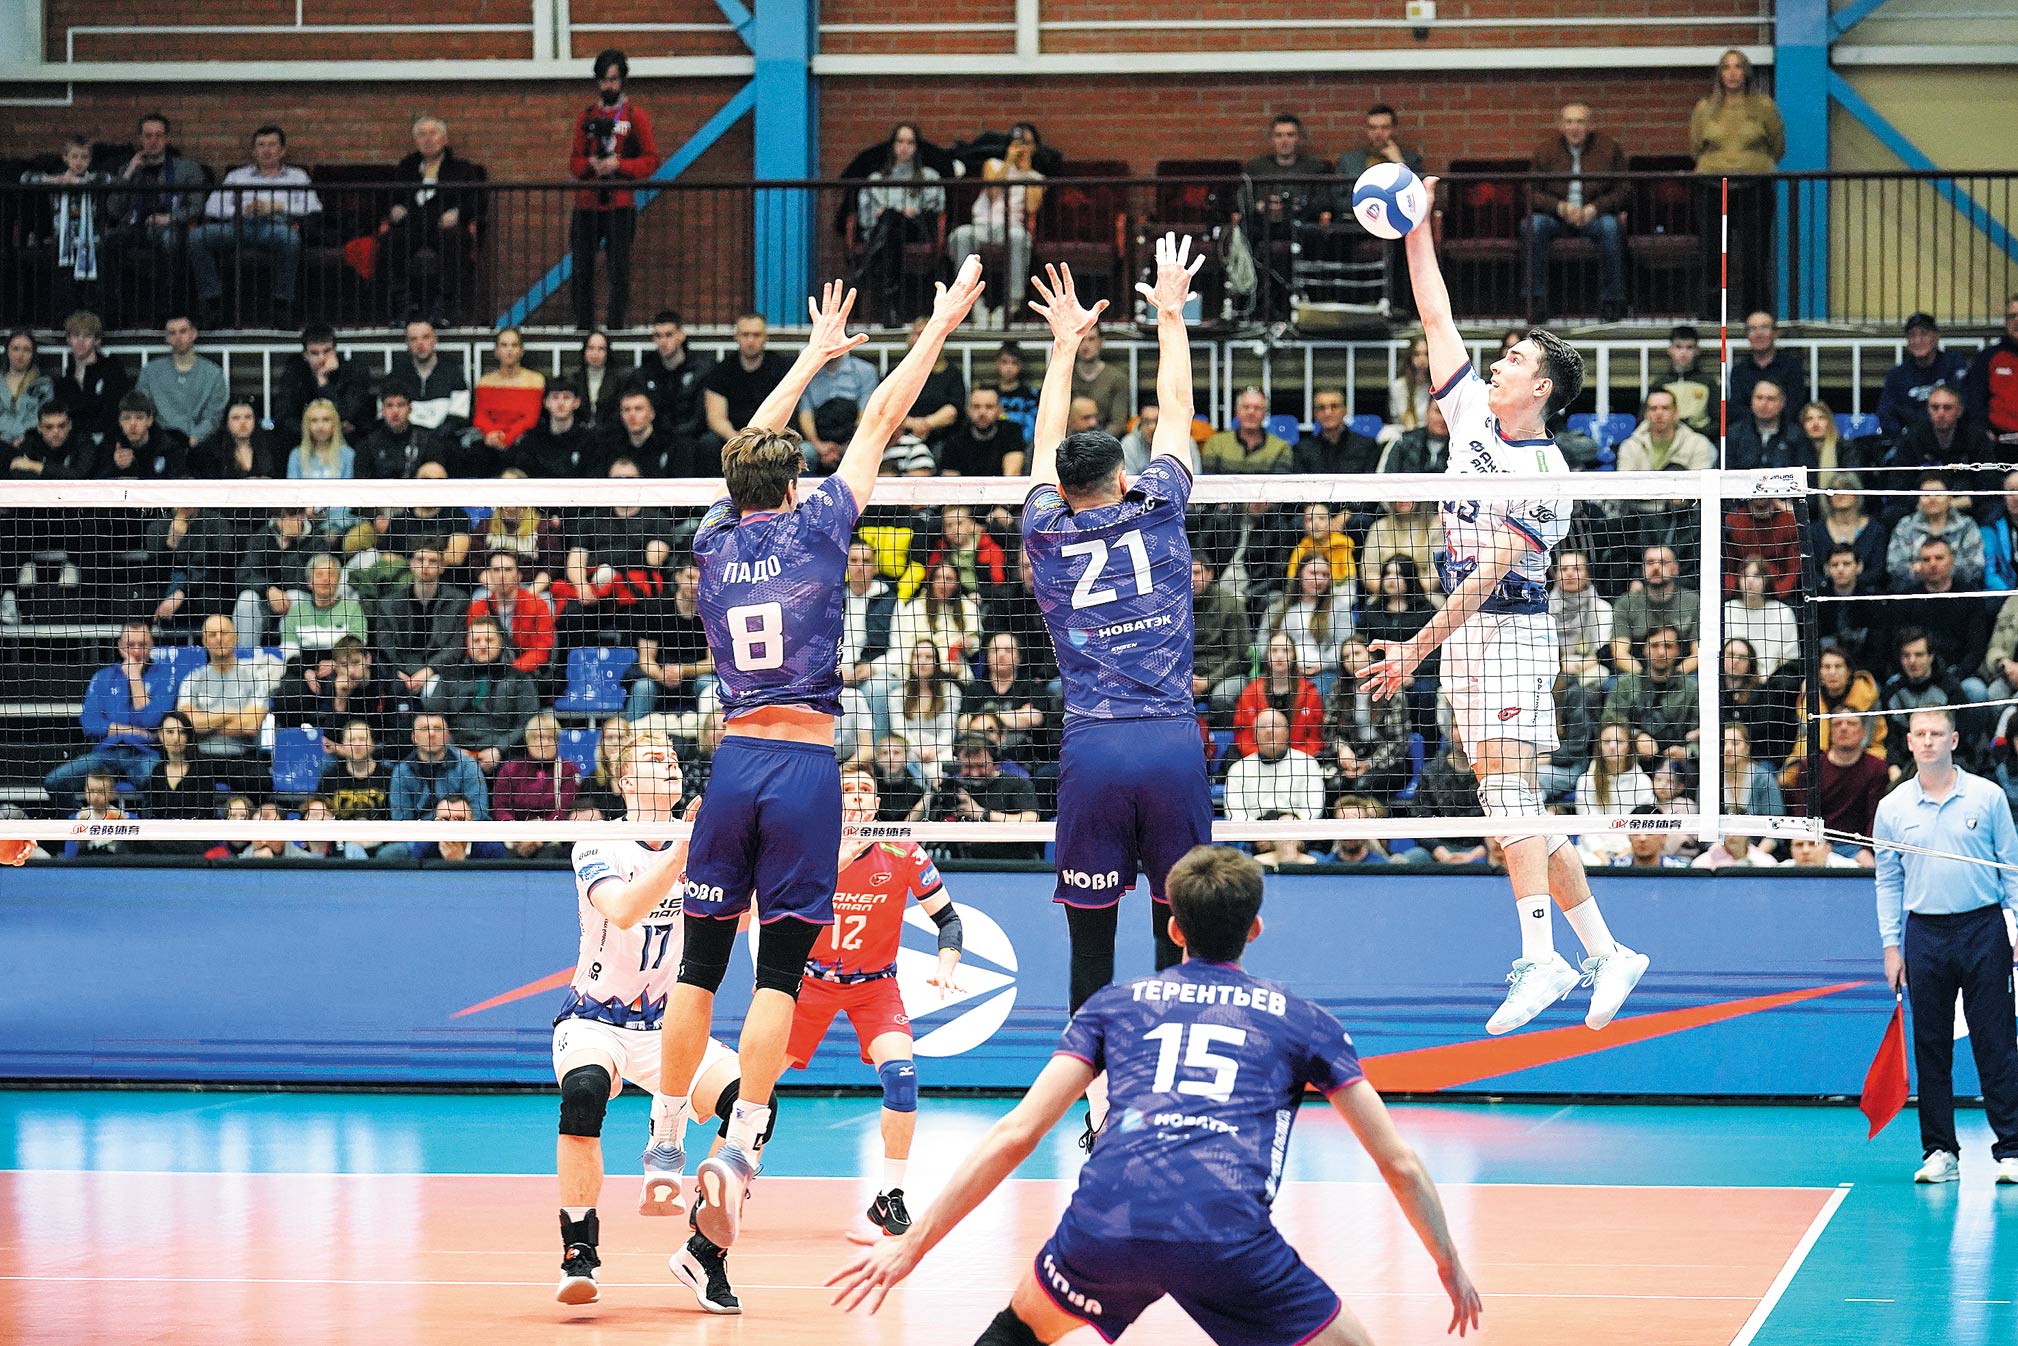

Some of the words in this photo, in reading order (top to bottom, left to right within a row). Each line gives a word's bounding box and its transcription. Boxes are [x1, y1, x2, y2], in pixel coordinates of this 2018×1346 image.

[722, 554, 782, 584] ПАДО
[1061, 528, 1154, 610] 21
[726, 601, 784, 672] 8
[1097, 613, 1173, 639] НОВАТЭК
[832, 892, 888, 904] АКЕЛ
[1062, 869, 1119, 890] НОВА
[639, 922, 673, 972] 17
[831, 914, 867, 951] 12
[1132, 980, 1287, 1017] ТЕРЕНТЬЕВ
[1143, 1022, 1247, 1102] 15
